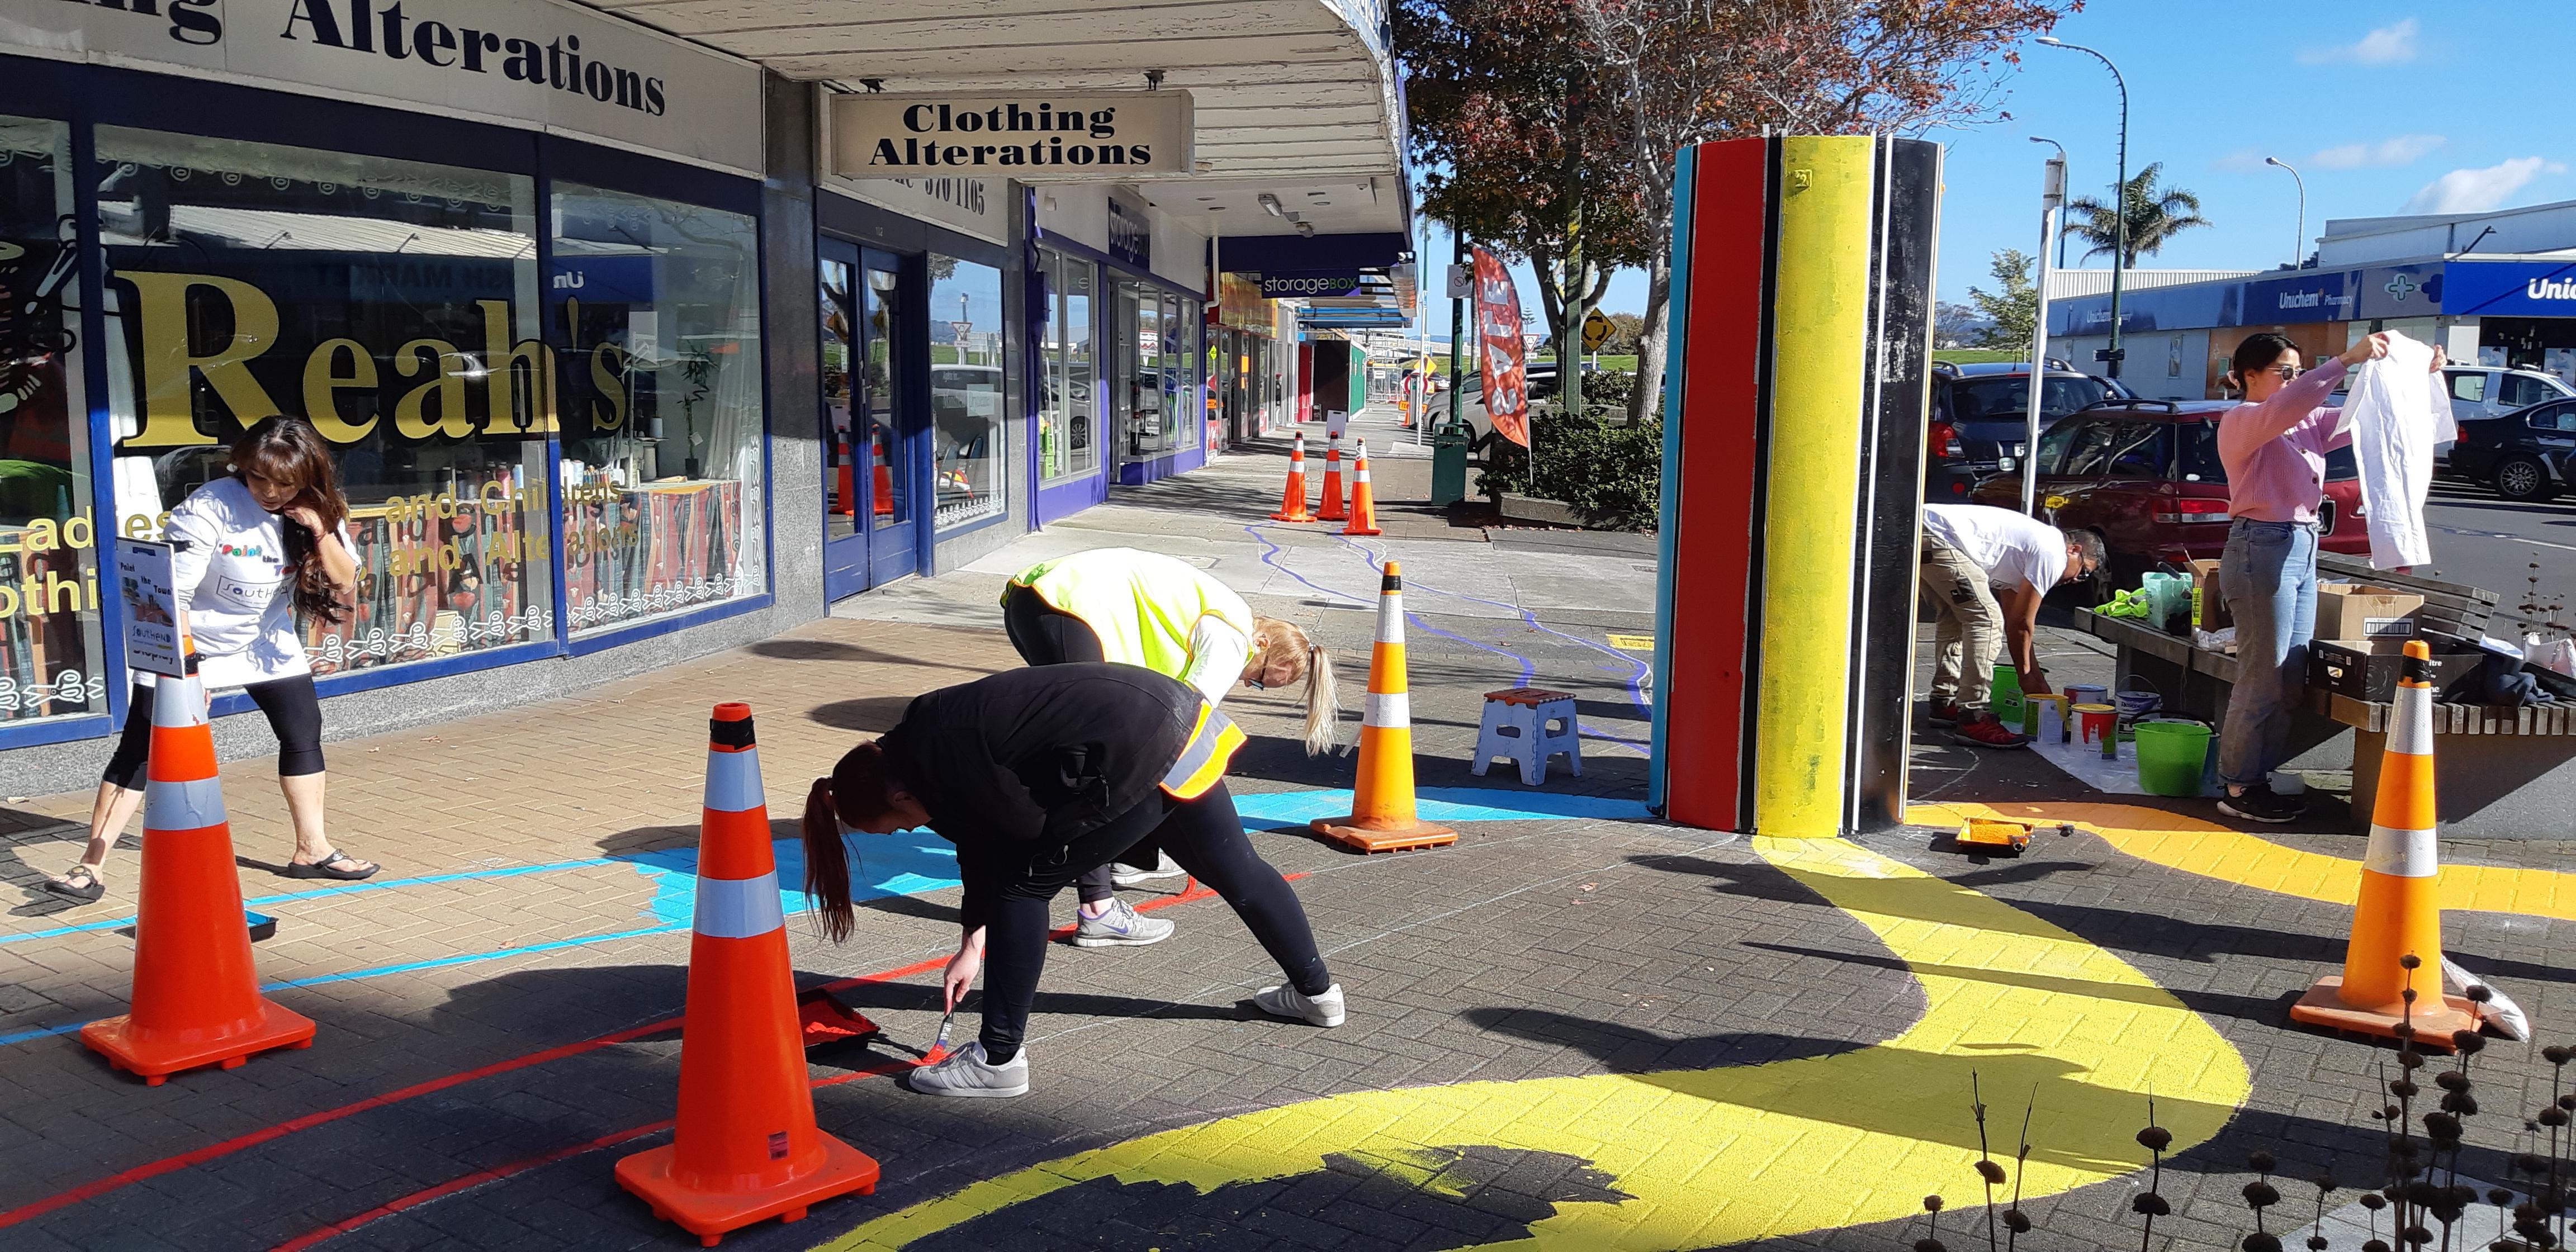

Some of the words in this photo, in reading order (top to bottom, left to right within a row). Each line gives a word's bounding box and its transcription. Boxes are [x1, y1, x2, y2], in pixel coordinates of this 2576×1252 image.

[280, 0, 665, 116] Alterations
[903, 103, 1116, 139] Clothing
[868, 137, 1151, 165] Alterations
[2279, 290, 2318, 309] Unichem
[113, 269, 627, 447] Reah's
[1483, 278, 1517, 415] SALE
[386, 482, 458, 524] and
[389, 533, 462, 577] and
[141, 575, 151, 585] the
